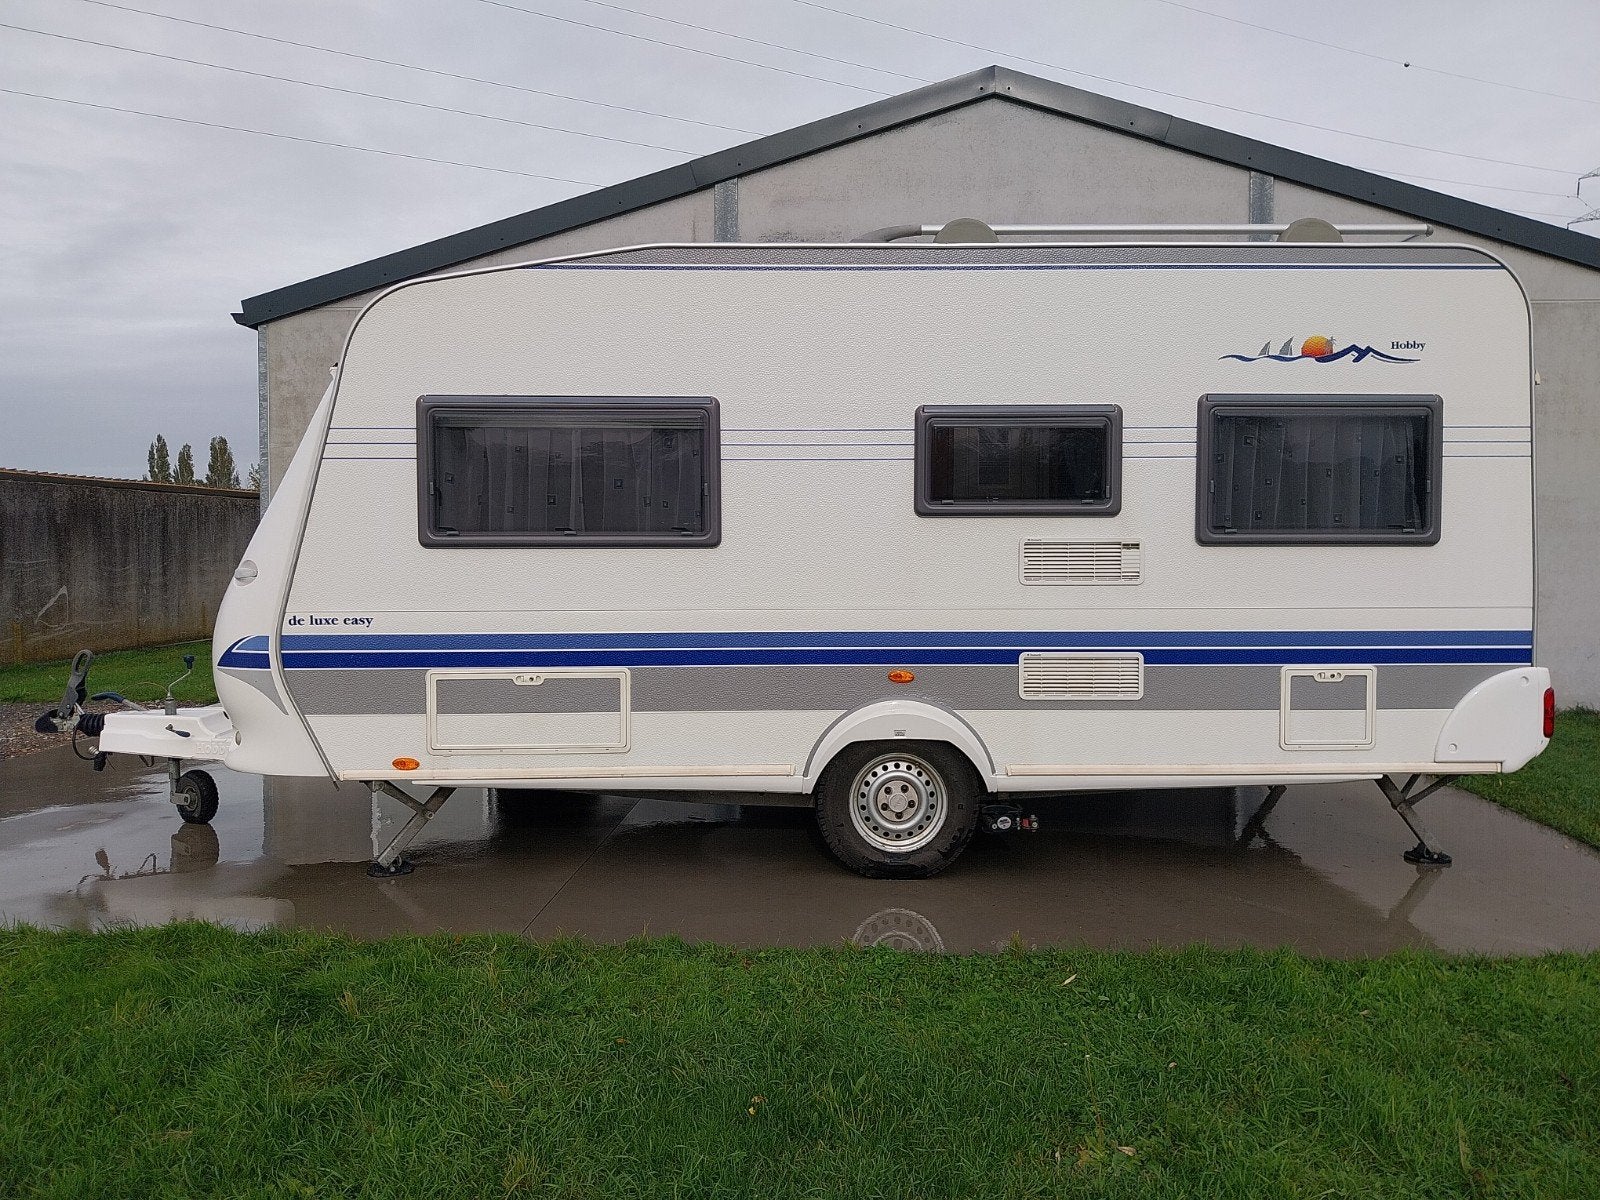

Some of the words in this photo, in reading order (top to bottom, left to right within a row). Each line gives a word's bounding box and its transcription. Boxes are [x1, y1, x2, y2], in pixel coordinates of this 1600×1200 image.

[1391, 340, 1426, 351] Hobby
[288, 615, 305, 626] de
[309, 615, 339, 626] luxe
[343, 617, 374, 628] easy
